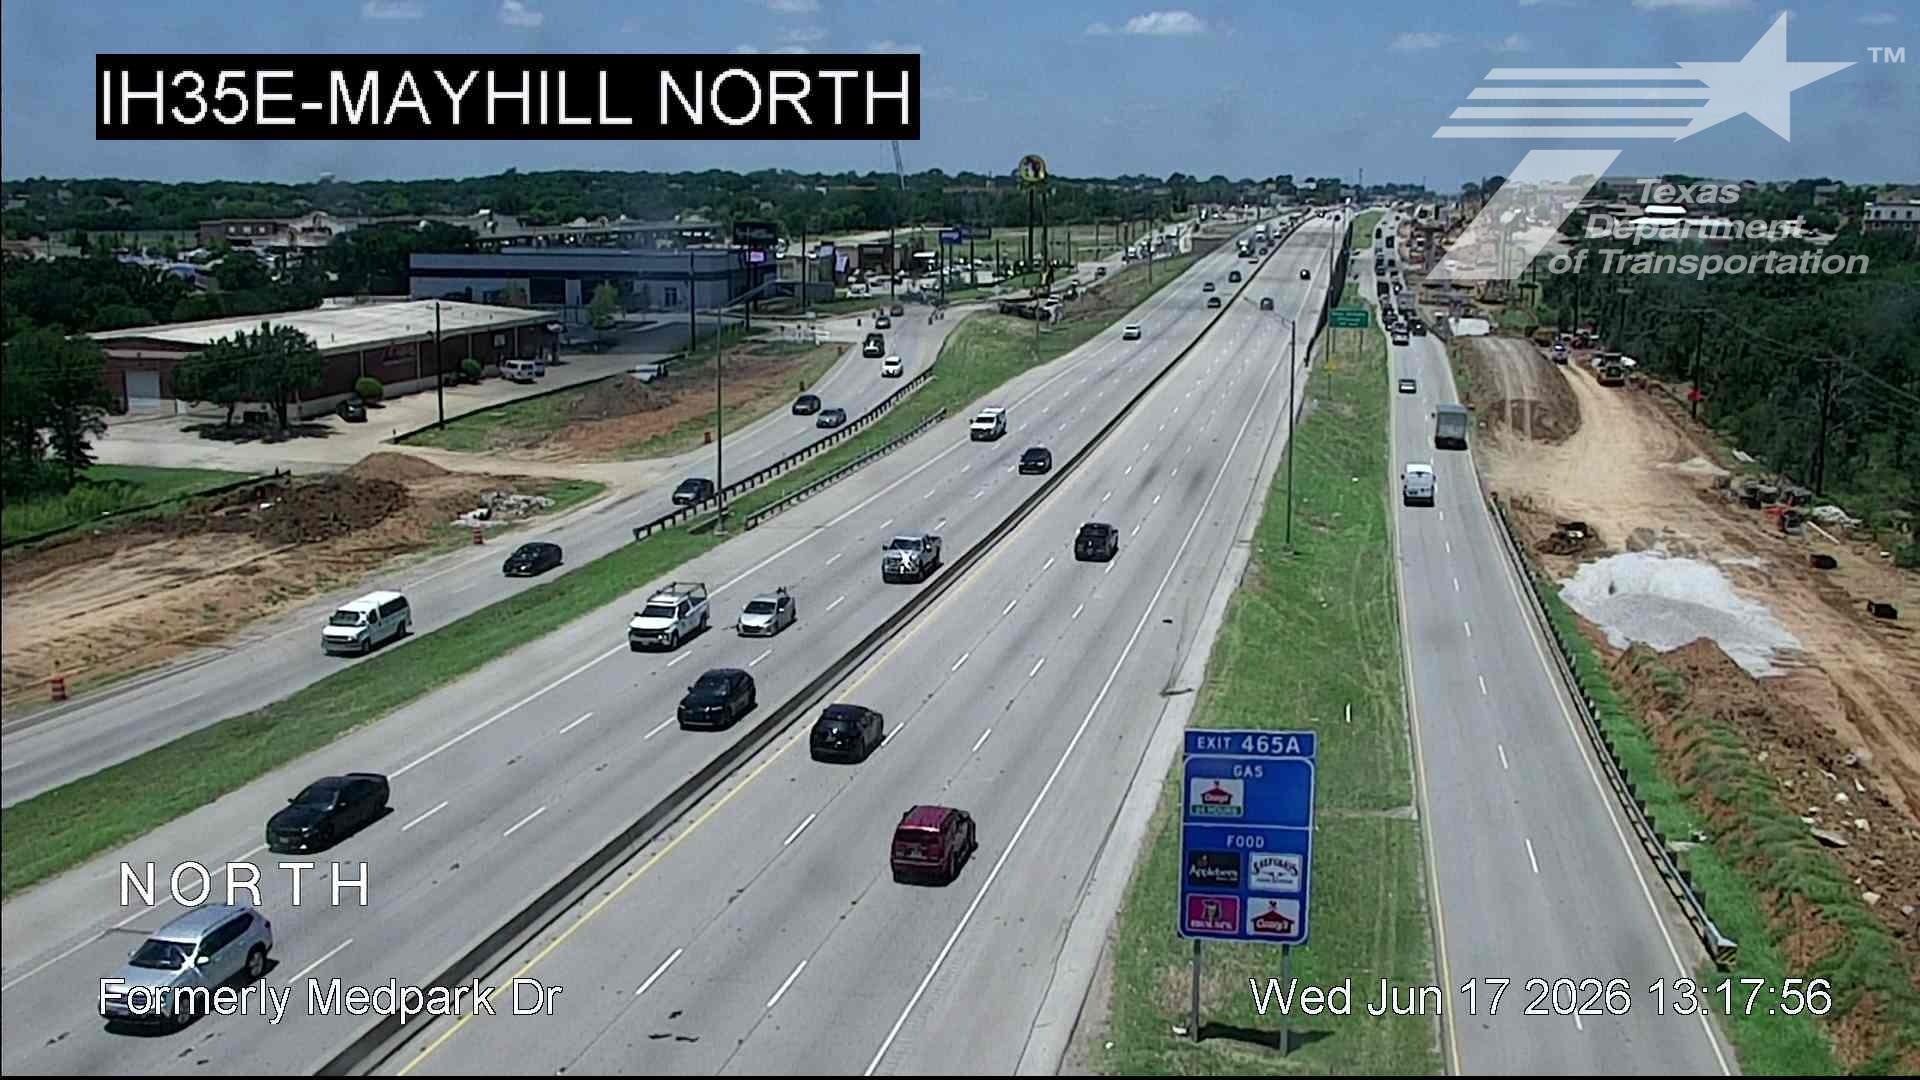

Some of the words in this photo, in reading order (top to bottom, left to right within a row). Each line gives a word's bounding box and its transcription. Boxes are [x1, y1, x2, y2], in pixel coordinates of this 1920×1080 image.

[1197, 736, 1231, 750] EXIT
[1241, 735, 1301, 754] 465A
[1233, 765, 1264, 778] GAS
[1226, 835, 1265, 848] FOOD
